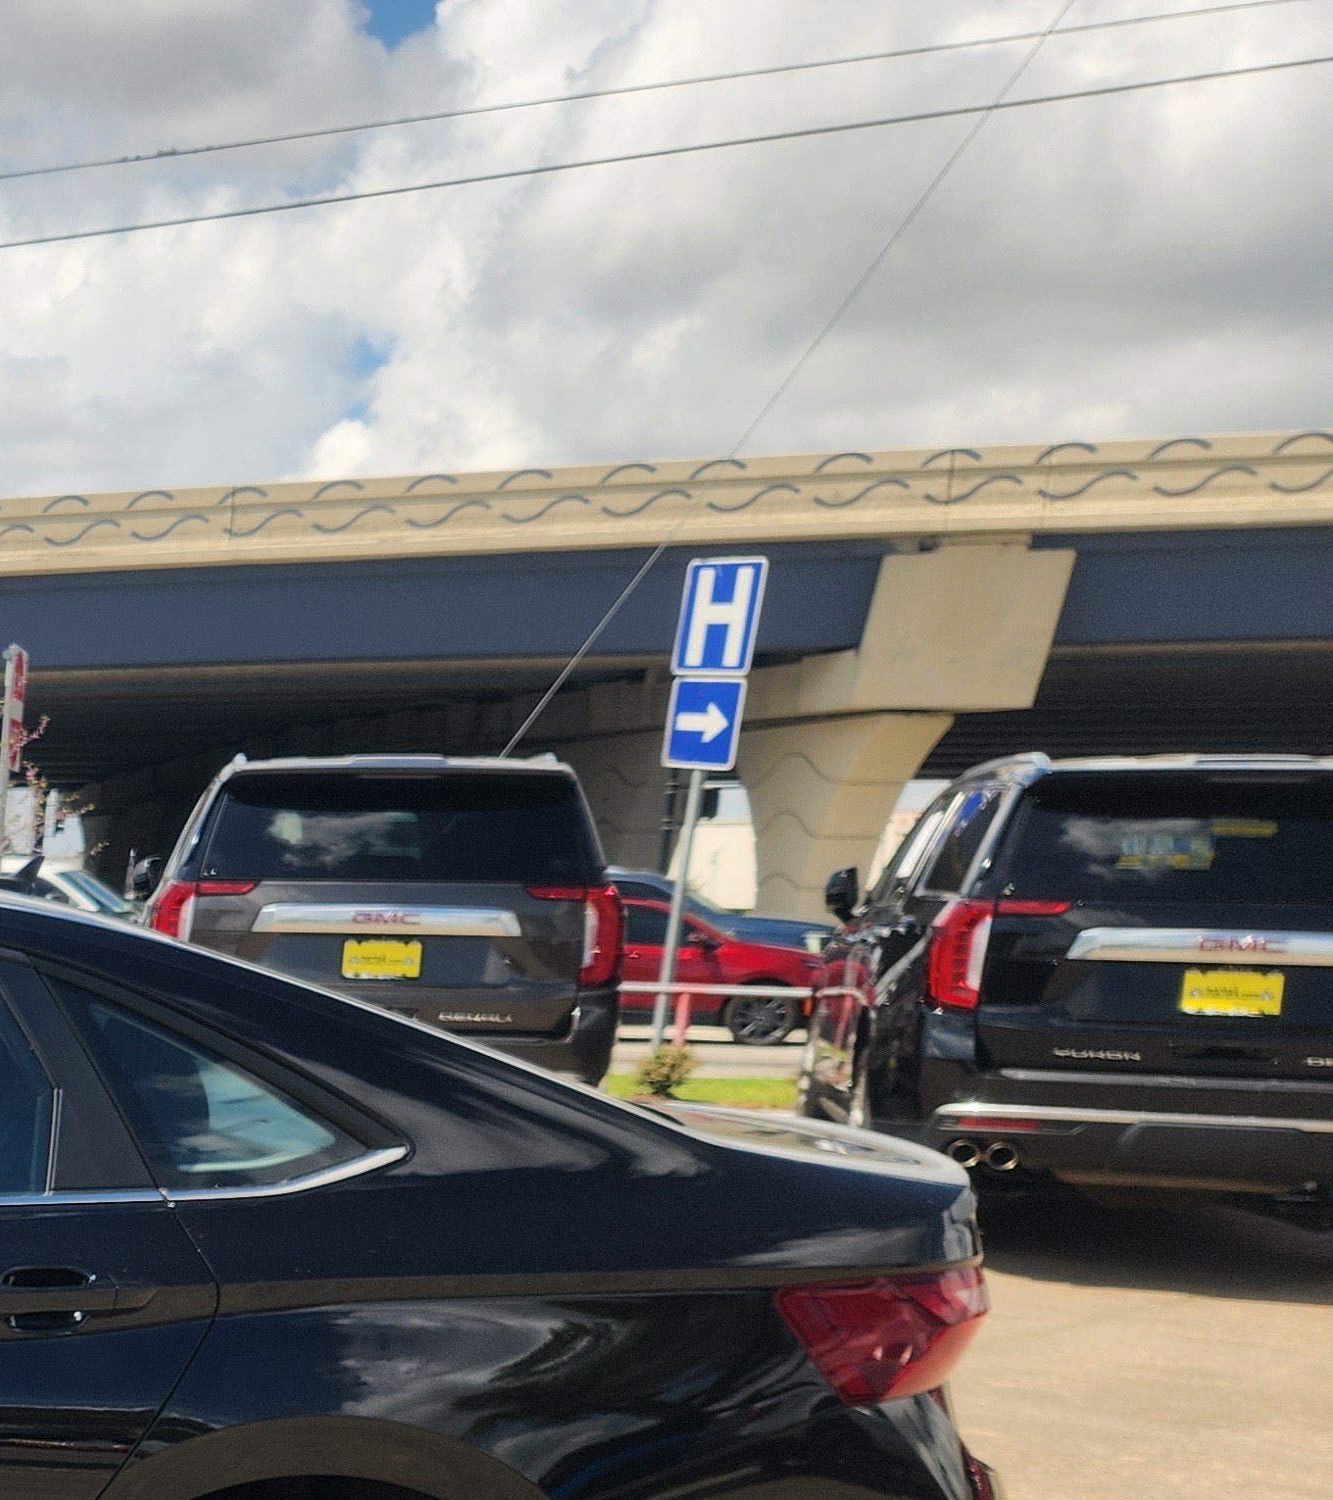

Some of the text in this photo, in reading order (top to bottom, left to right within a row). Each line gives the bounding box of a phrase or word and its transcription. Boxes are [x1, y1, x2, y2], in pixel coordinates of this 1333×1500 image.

[684, 567, 754, 667] H
[351, 910, 421, 925] GMC
[1198, 934, 1286, 954] GMC
